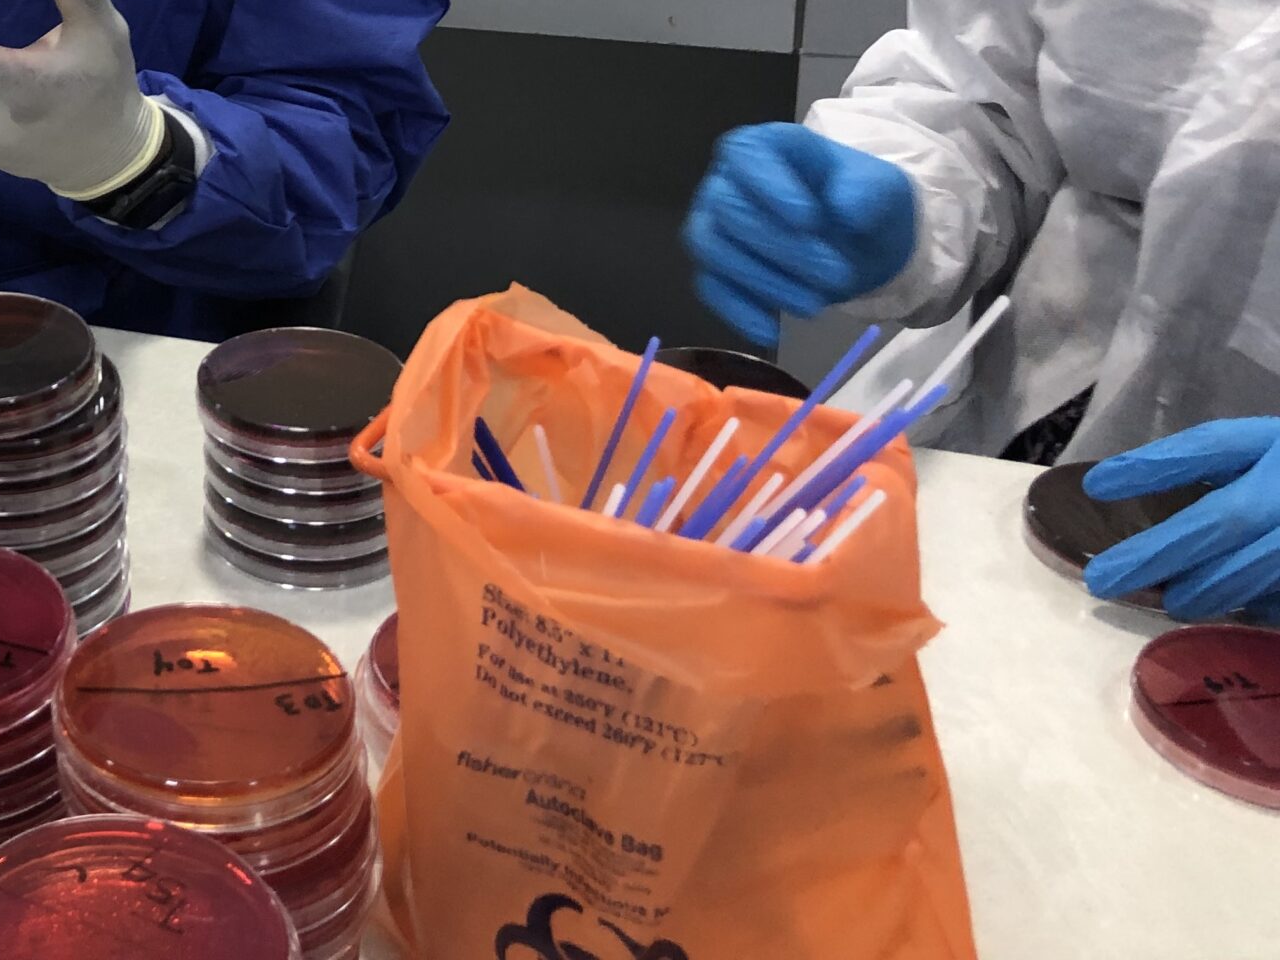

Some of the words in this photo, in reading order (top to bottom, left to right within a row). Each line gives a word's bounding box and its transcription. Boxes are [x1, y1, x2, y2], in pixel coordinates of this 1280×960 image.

[153, 649, 220, 677] T04
[478, 643, 507, 669] For
[508, 665, 536, 688] use
[541, 683, 559, 698] at
[274, 691, 343, 716] T03
[476, 664, 497, 689] Do
[499, 683, 527, 707] not
[533, 699, 597, 734] exceed
[621, 833, 664, 863] Bag
